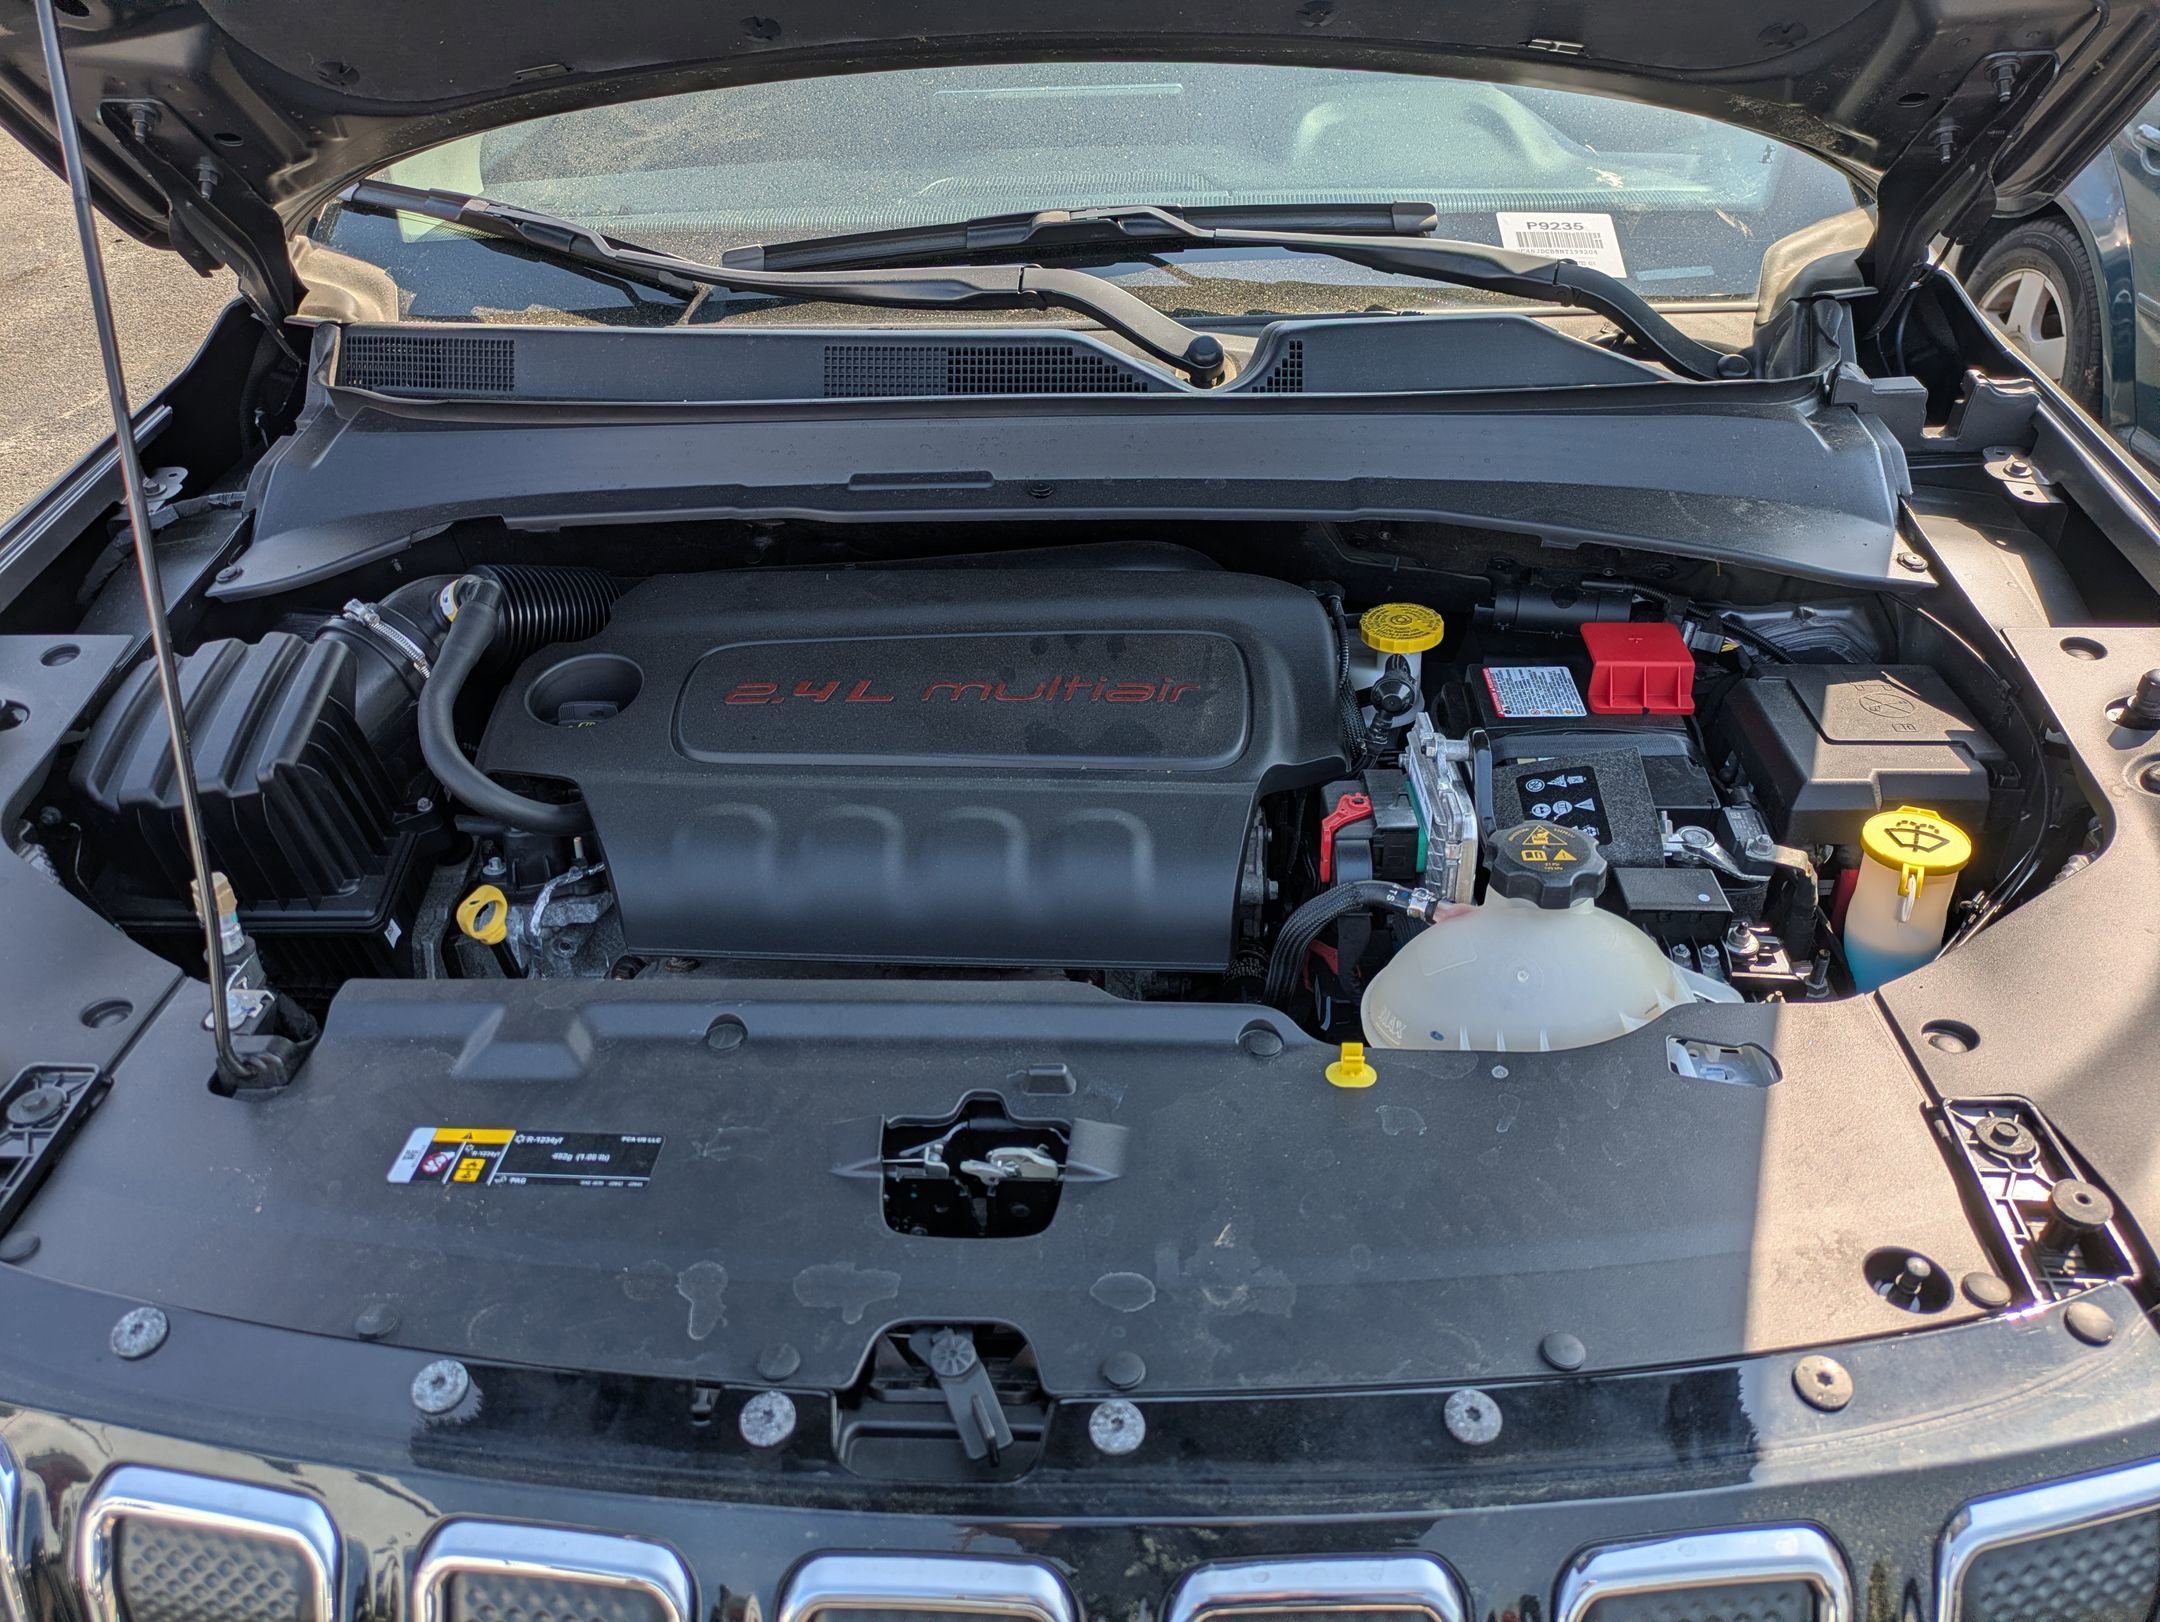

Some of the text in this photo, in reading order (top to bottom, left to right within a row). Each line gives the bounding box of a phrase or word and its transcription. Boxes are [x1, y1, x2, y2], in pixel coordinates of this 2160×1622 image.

[1526, 221, 1585, 231] P9235
[921, 674, 1201, 703] multiair
[1378, 1006, 1407, 1039] MAX
